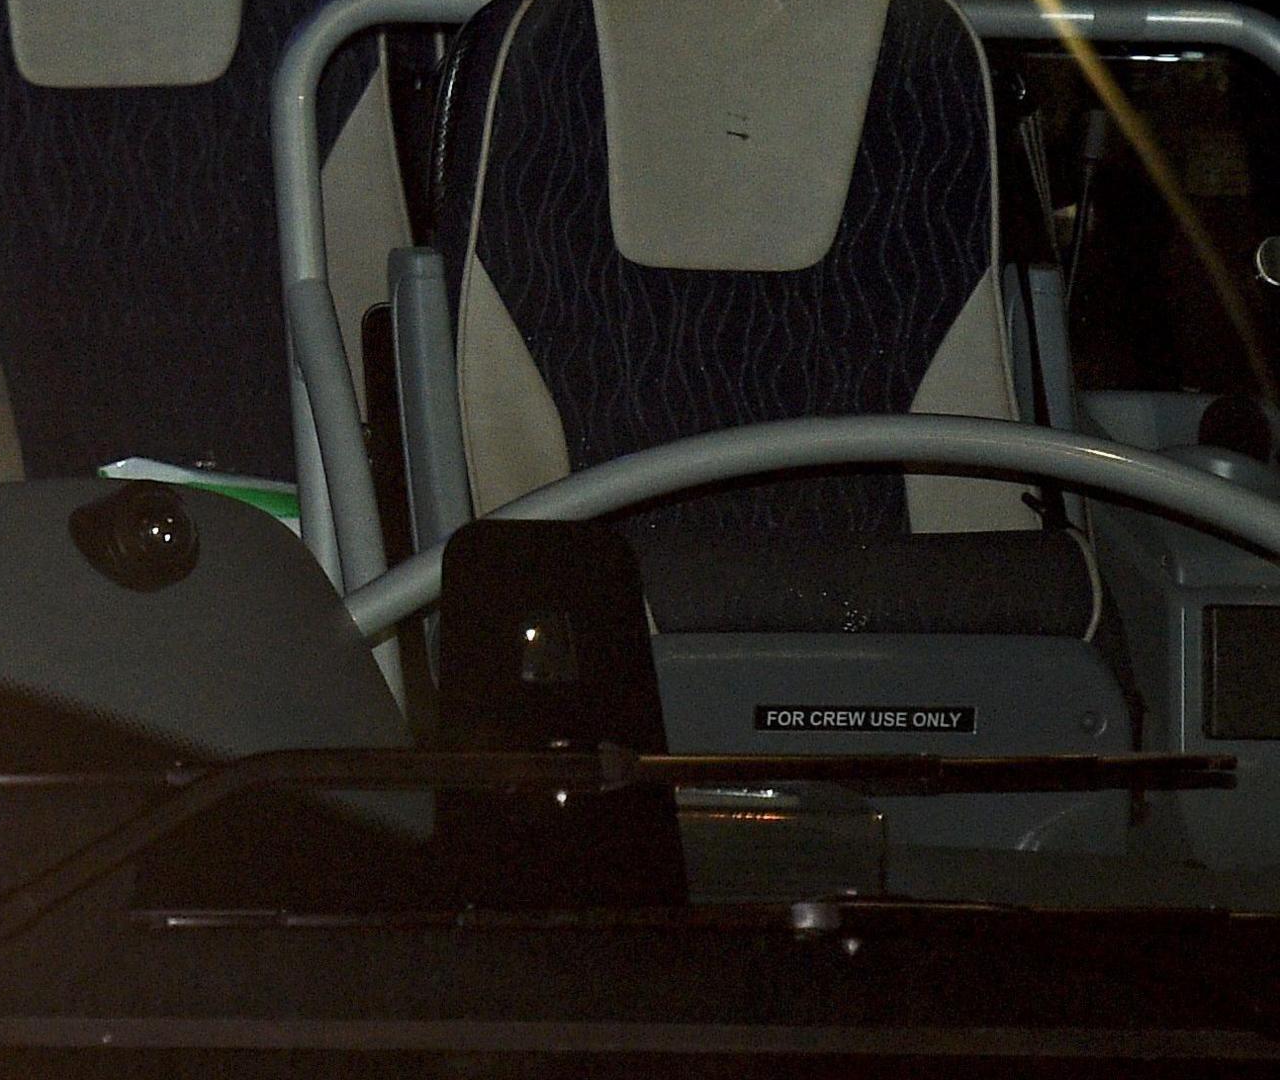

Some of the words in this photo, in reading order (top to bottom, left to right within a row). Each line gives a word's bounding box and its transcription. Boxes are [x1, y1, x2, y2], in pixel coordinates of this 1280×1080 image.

[766, 711, 805, 727] FOR
[809, 711, 867, 727] CREW
[870, 711, 908, 728] USE
[912, 711, 963, 728] ONLY
